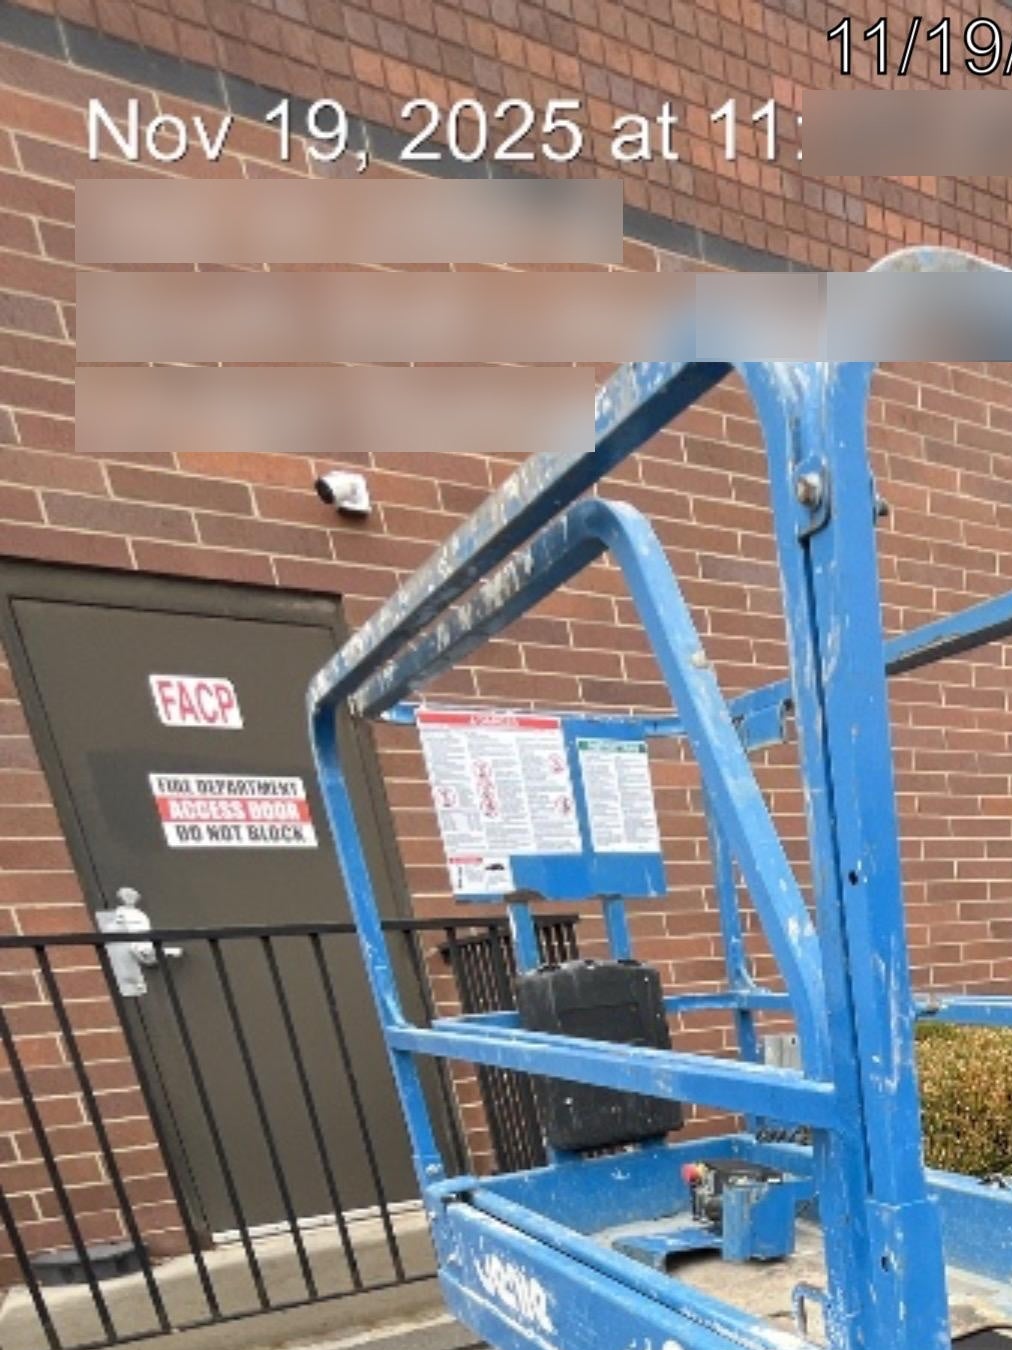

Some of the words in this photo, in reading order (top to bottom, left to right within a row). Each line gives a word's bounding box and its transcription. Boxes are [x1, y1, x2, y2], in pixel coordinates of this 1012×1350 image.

[156, 680, 236, 724] FACP
[168, 800, 243, 821] ACCESS
[174, 824, 203, 842] DO
[207, 824, 242, 842] NOT
[246, 824, 307, 843] BLOCK
